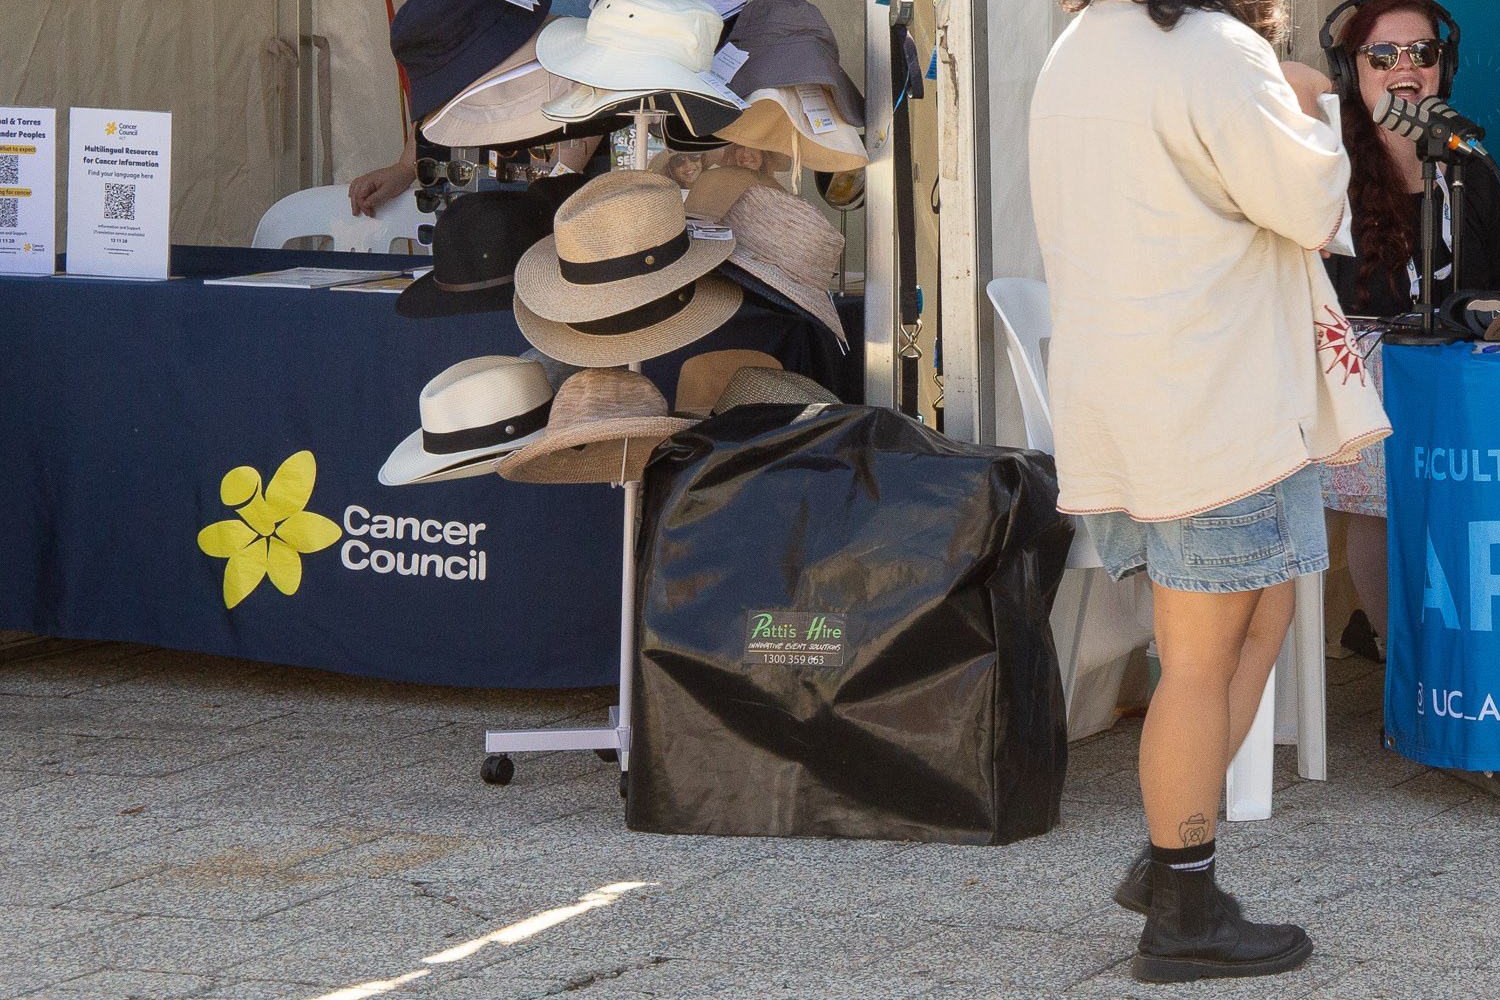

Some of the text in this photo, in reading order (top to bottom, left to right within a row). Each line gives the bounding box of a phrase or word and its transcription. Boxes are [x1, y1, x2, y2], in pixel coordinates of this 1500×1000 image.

[17, 118, 41, 126] Torres
[18, 131, 46, 140] Peoples
[84, 144, 159, 156] Multilingual Resources
[83, 156, 159, 168] for Cancer Information
[343, 504, 486, 546] Cancer
[341, 539, 486, 581] Council
[751, 613, 842, 641] Patti's Hire
[763, 654, 786, 664] 1300
[787, 654, 806, 664] 359
